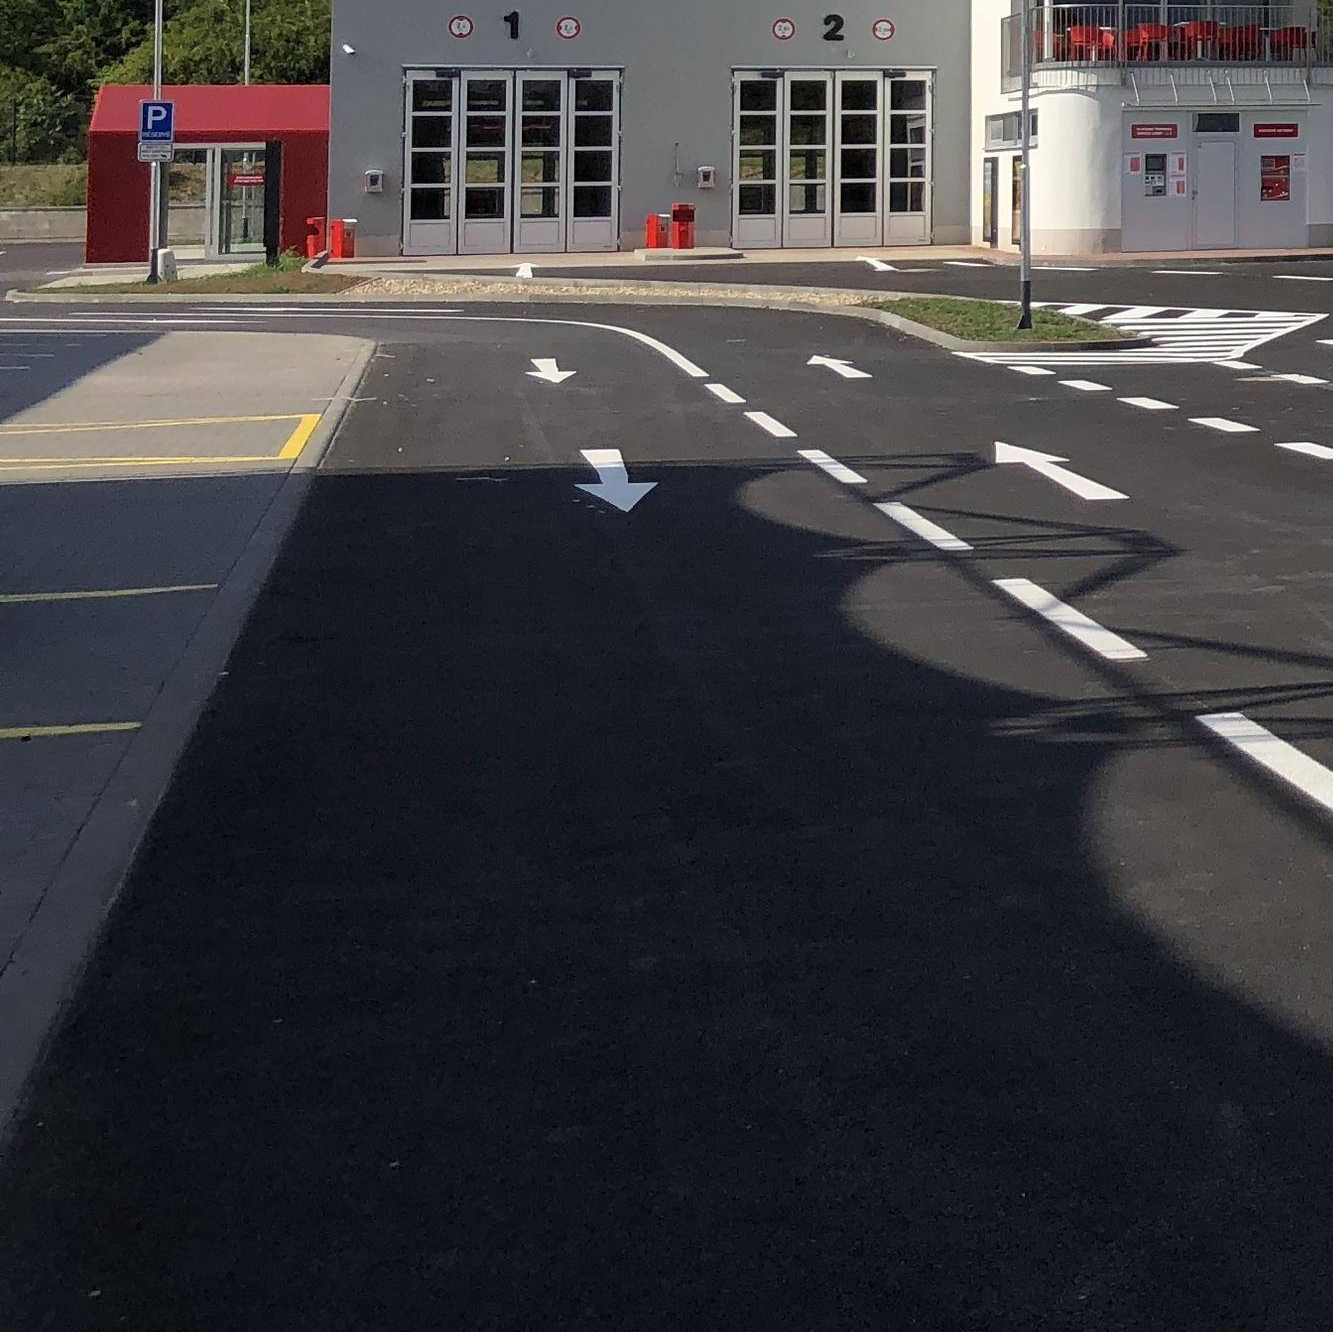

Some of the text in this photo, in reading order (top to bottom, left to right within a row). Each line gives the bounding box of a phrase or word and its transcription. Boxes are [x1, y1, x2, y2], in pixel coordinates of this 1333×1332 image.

[503, 10, 520, 40] 1
[823, 14, 845, 41] 2
[147, 105, 168, 130] P
